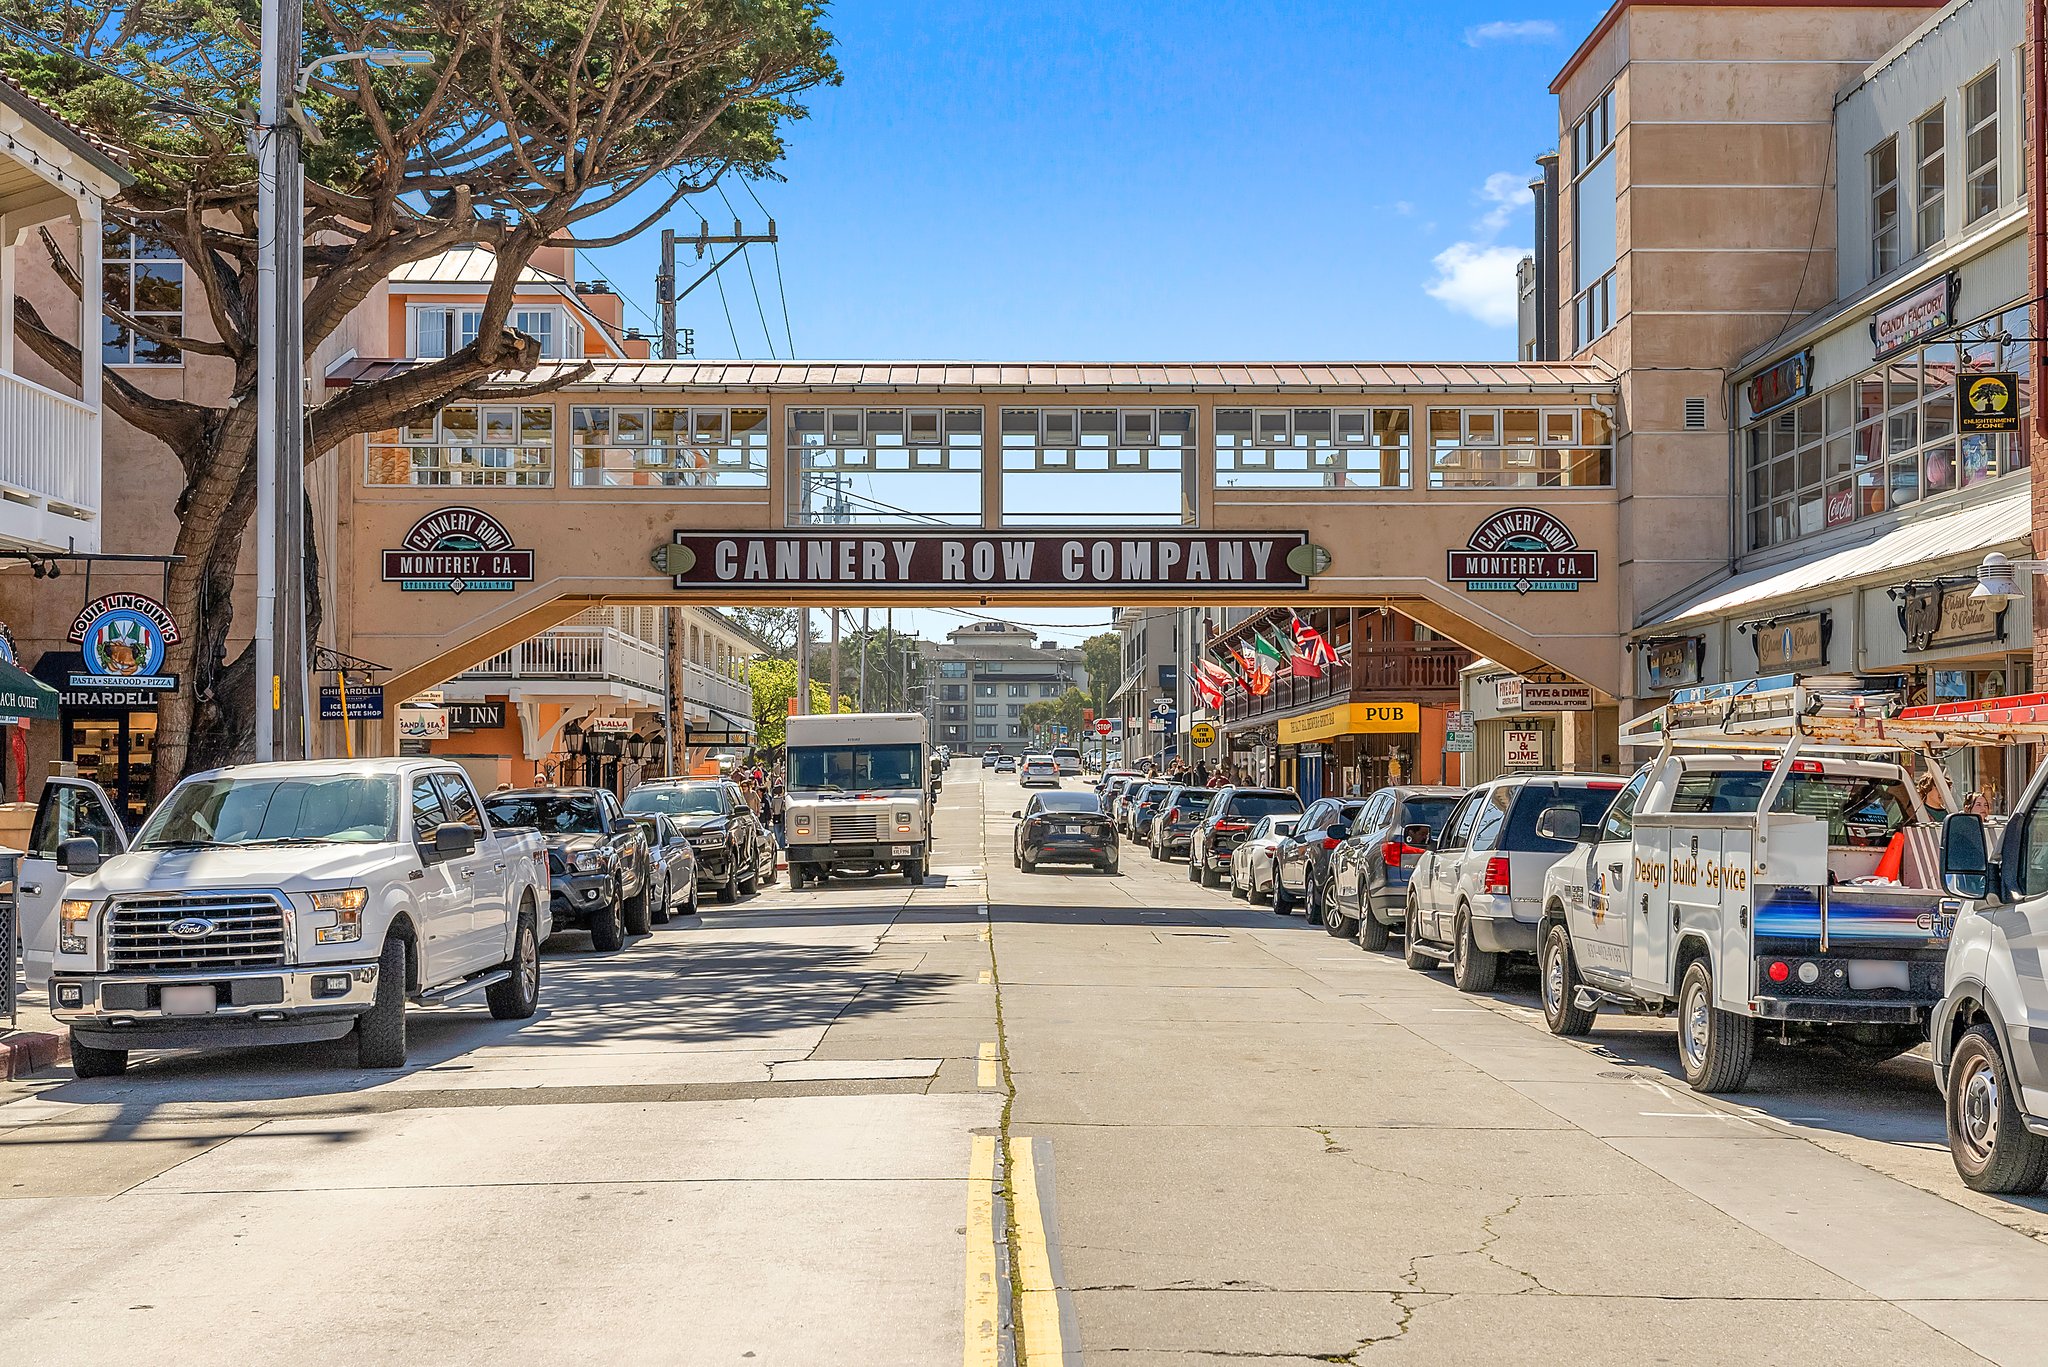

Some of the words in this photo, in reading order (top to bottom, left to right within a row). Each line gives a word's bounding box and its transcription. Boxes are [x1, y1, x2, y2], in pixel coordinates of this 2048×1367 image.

[1880, 313, 1907, 337] CANDY
[1908, 294, 1944, 324] FACTORY
[1963, 417, 2016, 425] ENLIGHTENMENT
[413, 513, 476, 549] CANNERY
[475, 519, 505, 549] ROW
[1478, 514, 1541, 549] CANNERY
[1539, 520, 1570, 550] ROW
[400, 556, 486, 576] MONTEREY,
[493, 556, 518, 574] CA.
[715, 540, 916, 581] CANNERY
[942, 540, 1035, 581] ROW
[1061, 540, 1274, 581] COMPANY
[1466, 557, 1551, 577] MONTEREY,
[1557, 557, 1582, 575] CA.
[404, 581, 447, 589] STEINBECK
[469, 581, 492, 590] PLAZA
[495, 581, 511, 590] TWO
[1470, 582, 1513, 590] STEINBECK
[1534, 582, 1557, 590] PLAZA
[1560, 582, 1576, 590] ONE
[70, 600, 107, 642] LOUIE
[106, 594, 178, 643] LINGUINI'S
[72, 677, 98, 685] PASTA
[103, 677, 142, 686] SEAFOOD
[147, 678, 172, 687] PIZZA
[58, 692, 158, 705] HIRARDELL
[1525, 689, 1551, 698] FIVE
[1552, 689, 1560, 698] &
[1561, 689, 1590, 698] DIME
[0, 692, 16, 708] ACH
[18, 695, 39, 709] OUTLET
[469, 706, 499, 724] INN
[1366, 707, 1404, 721] PUB
[400, 721, 419, 729] SAND
[426, 721, 440, 729] SEA
[600, 720, 628, 728] LALLA
[1097, 723, 1112, 731] STOP
[1509, 732, 1536, 742] FIVE
[1519, 742, 1528, 751] &
[1508, 751, 1539, 760] DIME
[1635, 857, 1666, 890] Design
[1673, 858, 1698, 888] Build
[1706, 859, 1747, 892] Service
[177, 923, 202, 934] Ford
[1916, 914, 1954, 931] CHU
